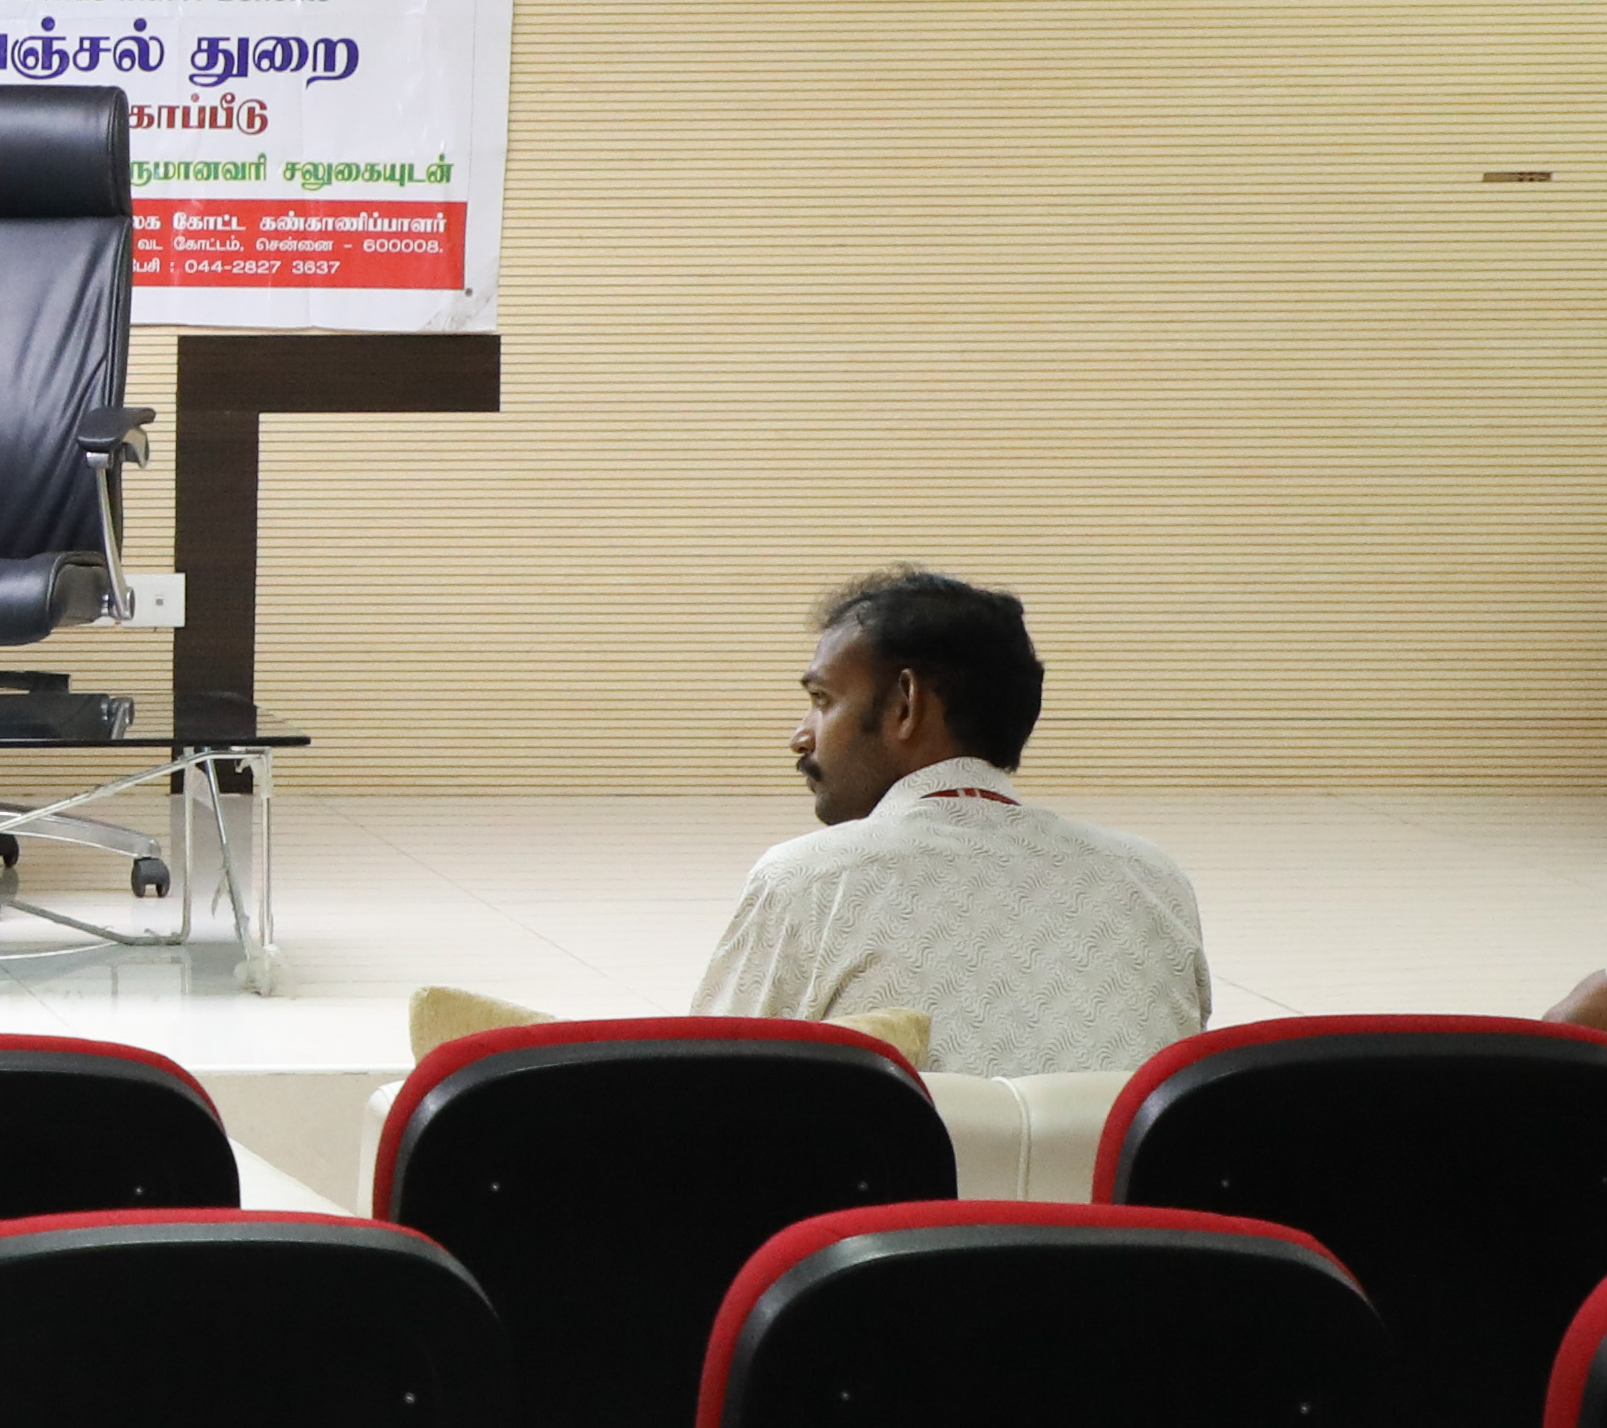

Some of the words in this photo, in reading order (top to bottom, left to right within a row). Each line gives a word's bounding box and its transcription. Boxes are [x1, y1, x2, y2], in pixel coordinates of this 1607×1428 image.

[189, 35, 360, 91] துறை
[129, 92, 269, 135] காப்பீடு
[283, 153, 455, 191] சலுகையுடன்
[173, 211, 246, 233] கோட்ட
[259, 210, 447, 233] கண்காணிப்பாளர்
[256, 236, 334, 253] சென்னை
[363, 238, 444, 254] 600008.
[185, 259, 281, 275] 044-2827
[292, 260, 342, 275] 3637
